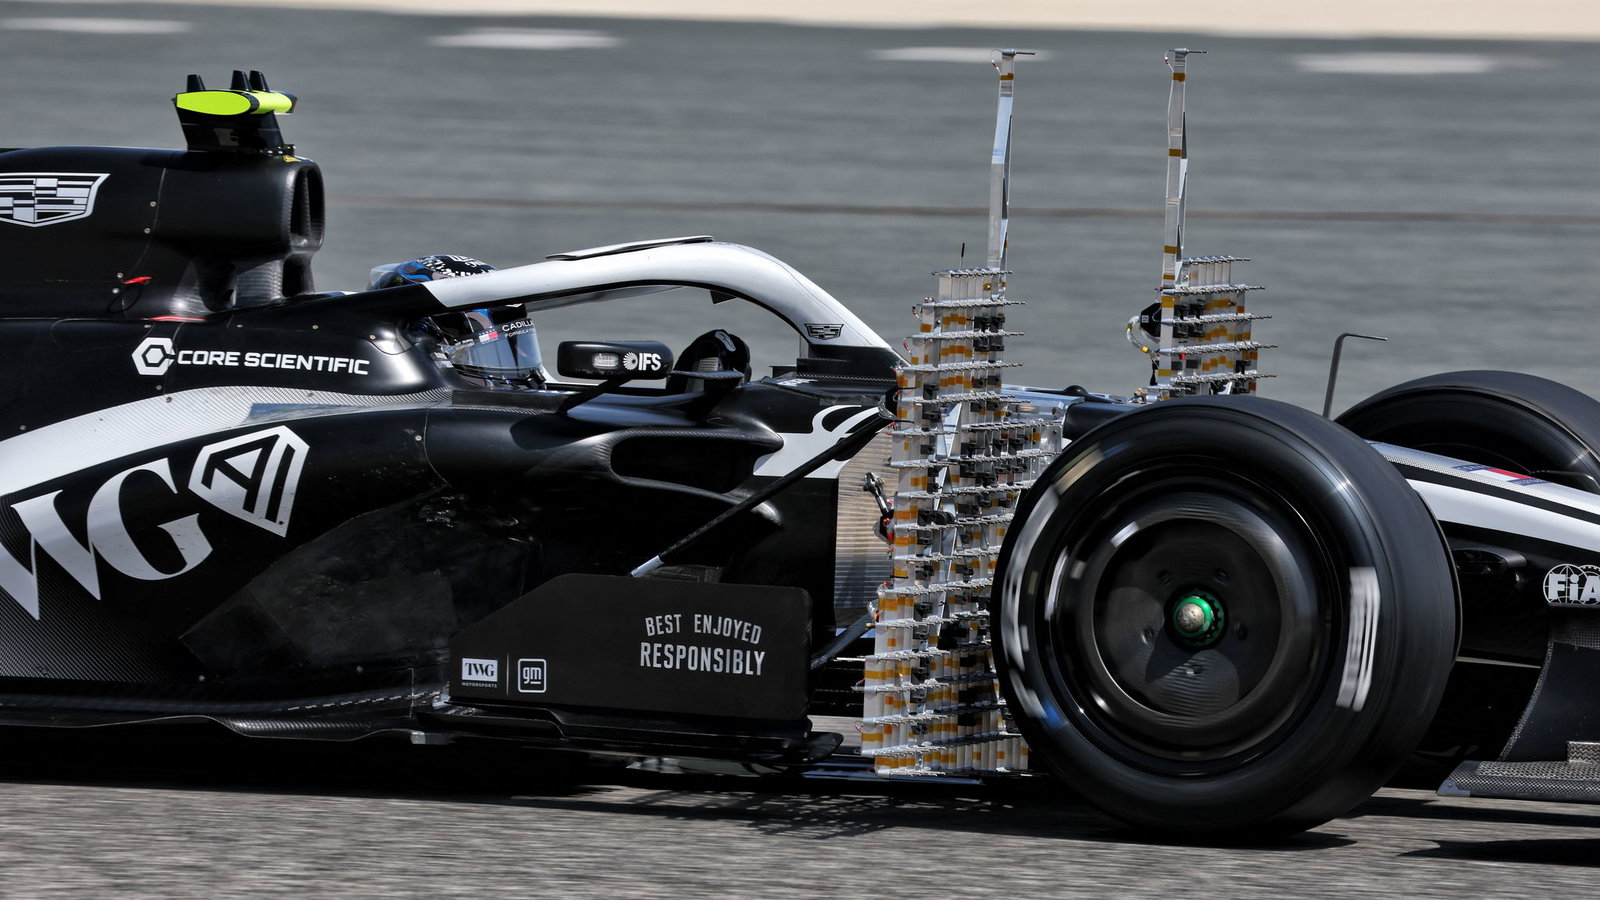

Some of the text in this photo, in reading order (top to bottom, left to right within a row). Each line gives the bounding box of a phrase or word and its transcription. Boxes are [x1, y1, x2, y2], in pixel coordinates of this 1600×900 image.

[178, 351, 370, 375] CORE SCIENTIFIC
[638, 352, 662, 371] IFS
[645, 614, 762, 645] BEST ENJOYED
[465, 662, 494, 677] TWG
[640, 642, 765, 676] RESPONSIBLY
[522, 667, 542, 684] gm
